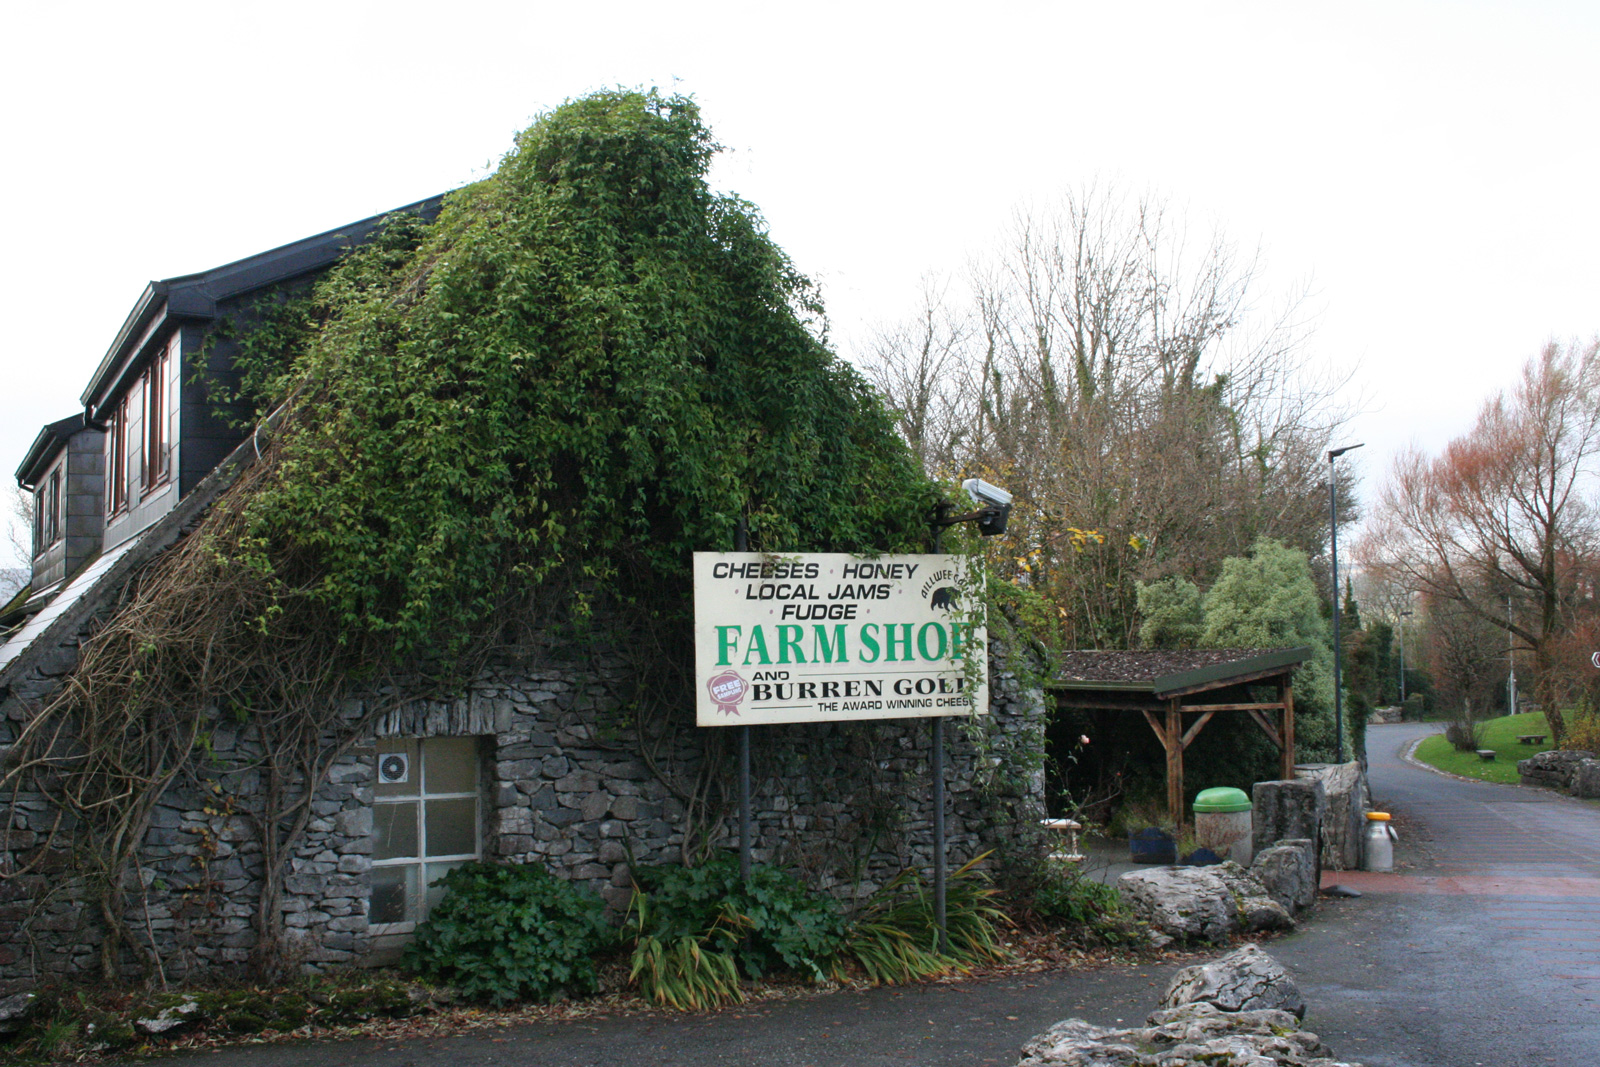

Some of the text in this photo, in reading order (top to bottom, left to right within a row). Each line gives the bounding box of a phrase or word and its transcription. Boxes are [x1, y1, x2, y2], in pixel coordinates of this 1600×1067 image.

[713, 563, 919, 579] CHEESES HONEY
[746, 584, 890, 600] LOCAL JAMS
[921, 570, 953, 599] AILLWEE
[781, 604, 857, 620] FUDGE
[752, 671, 789, 681] AND
[712, 679, 741, 695] FREE
[751, 680, 884, 701] BURREN
[817, 697, 974, 712] THE AWARD WINNING CHEES
